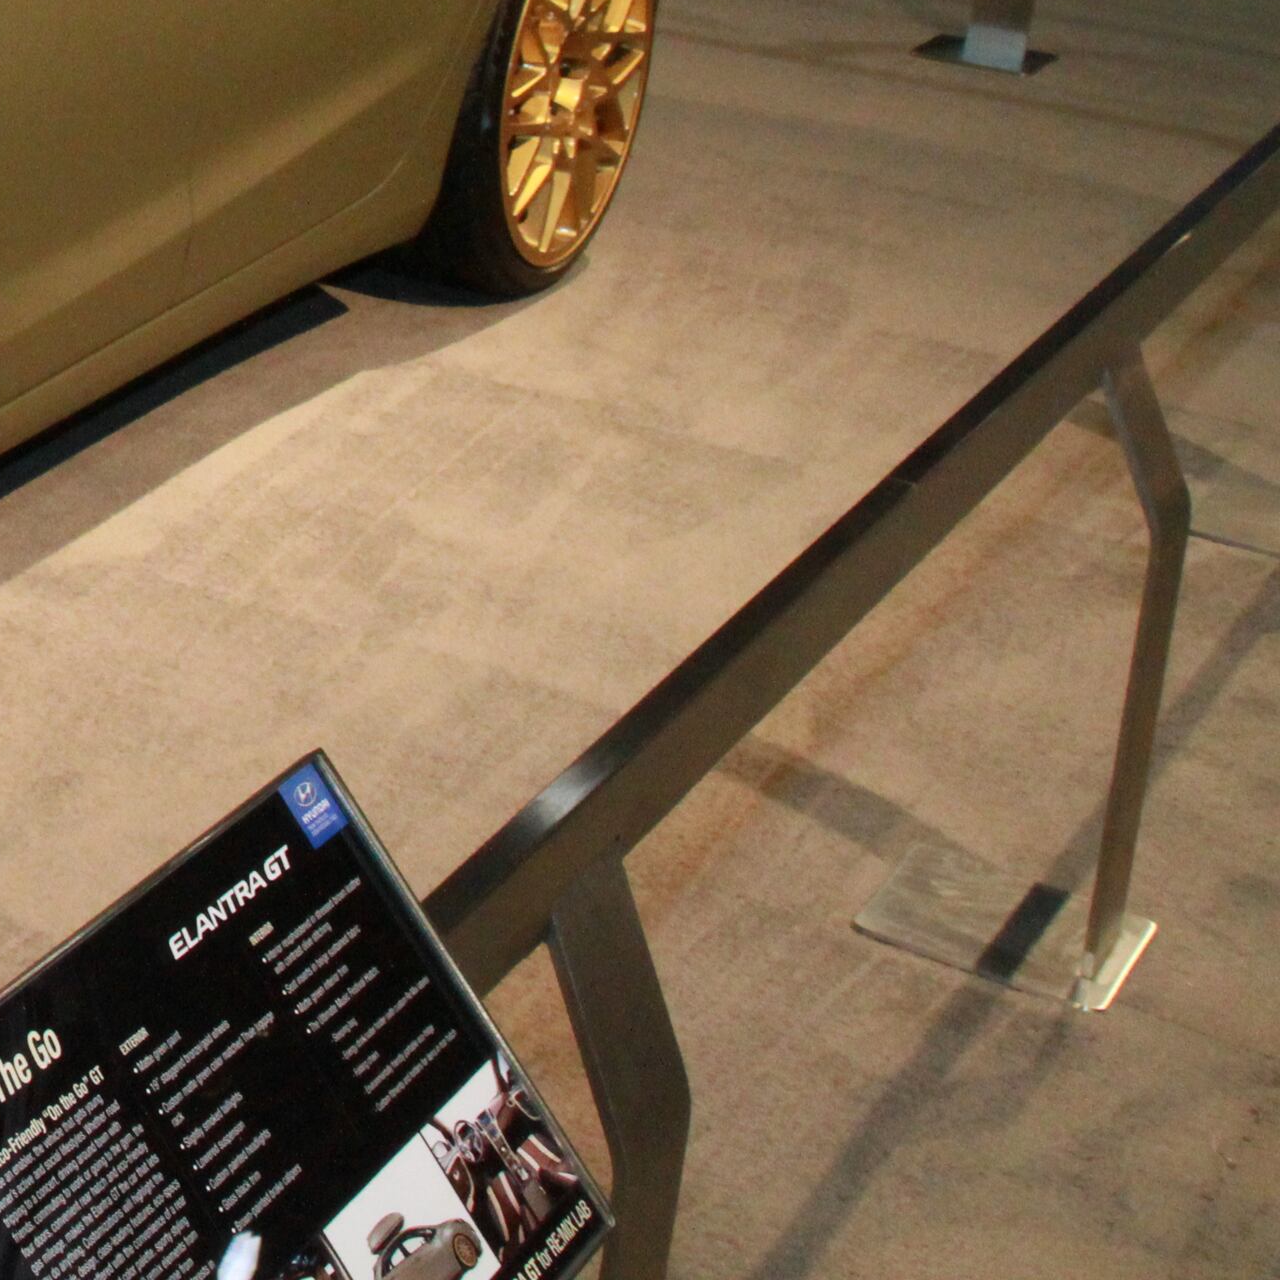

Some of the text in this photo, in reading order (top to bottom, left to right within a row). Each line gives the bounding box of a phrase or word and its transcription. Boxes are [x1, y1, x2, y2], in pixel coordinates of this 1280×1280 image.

[169, 871, 268, 961] ELANTRA
[263, 844, 291, 882] GT
[27, 1029, 62, 1070] Go
[119, 1027, 150, 1056] EXTERIOR
[59, 1092, 78, 1111] the
[89, 1065, 105, 1086] GT
[524, 1199, 592, 1280] GT for RE:MIX LAB
